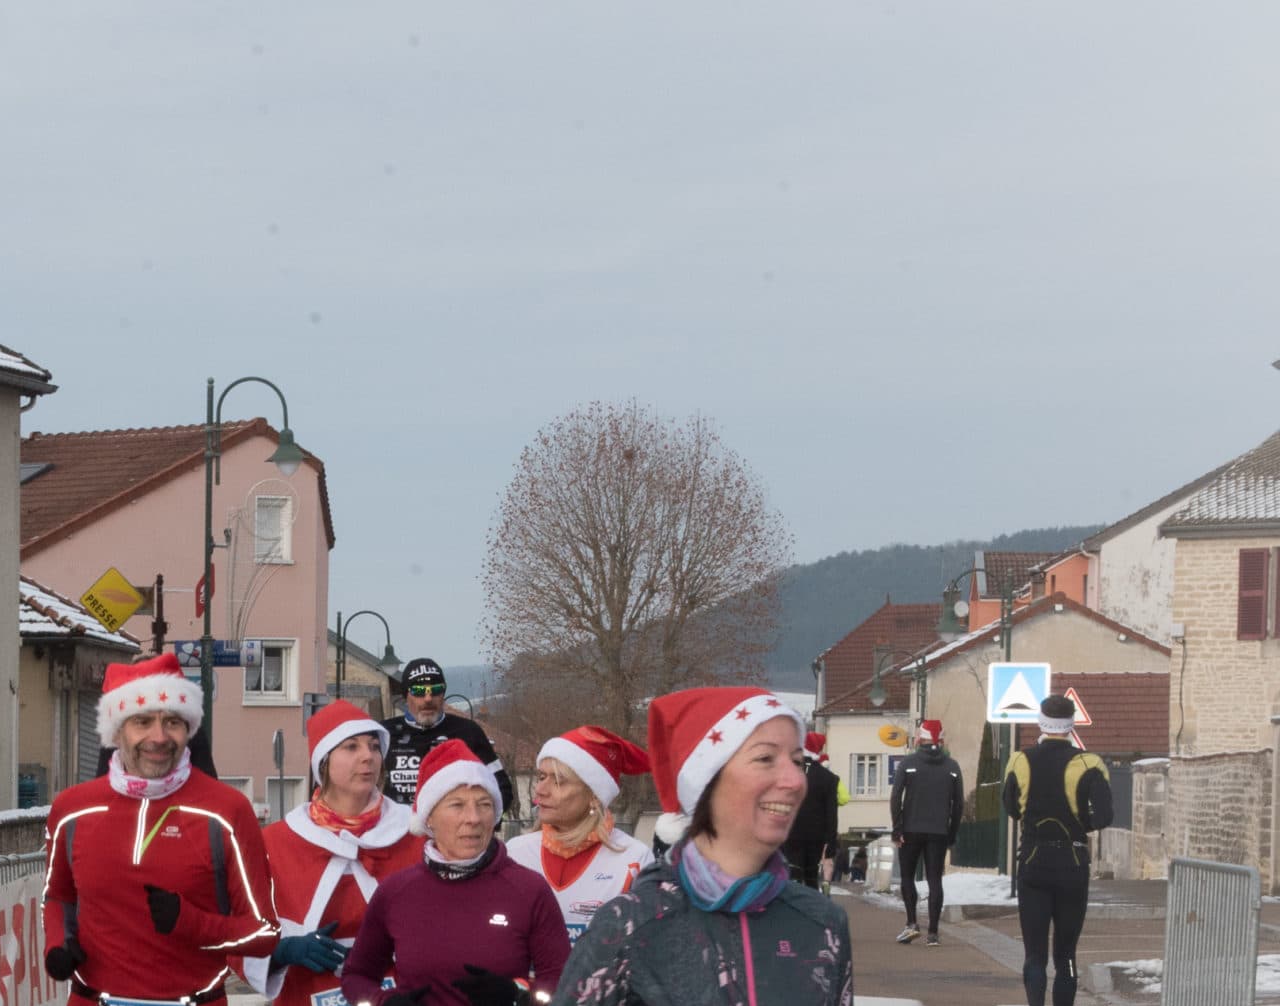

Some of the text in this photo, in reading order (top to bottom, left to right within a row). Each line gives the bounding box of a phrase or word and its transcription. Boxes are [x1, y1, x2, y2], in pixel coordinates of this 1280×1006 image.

[84, 594, 118, 629] PRESSE
[395, 756, 421, 770] EC
[392, 772, 418, 782] Chau
